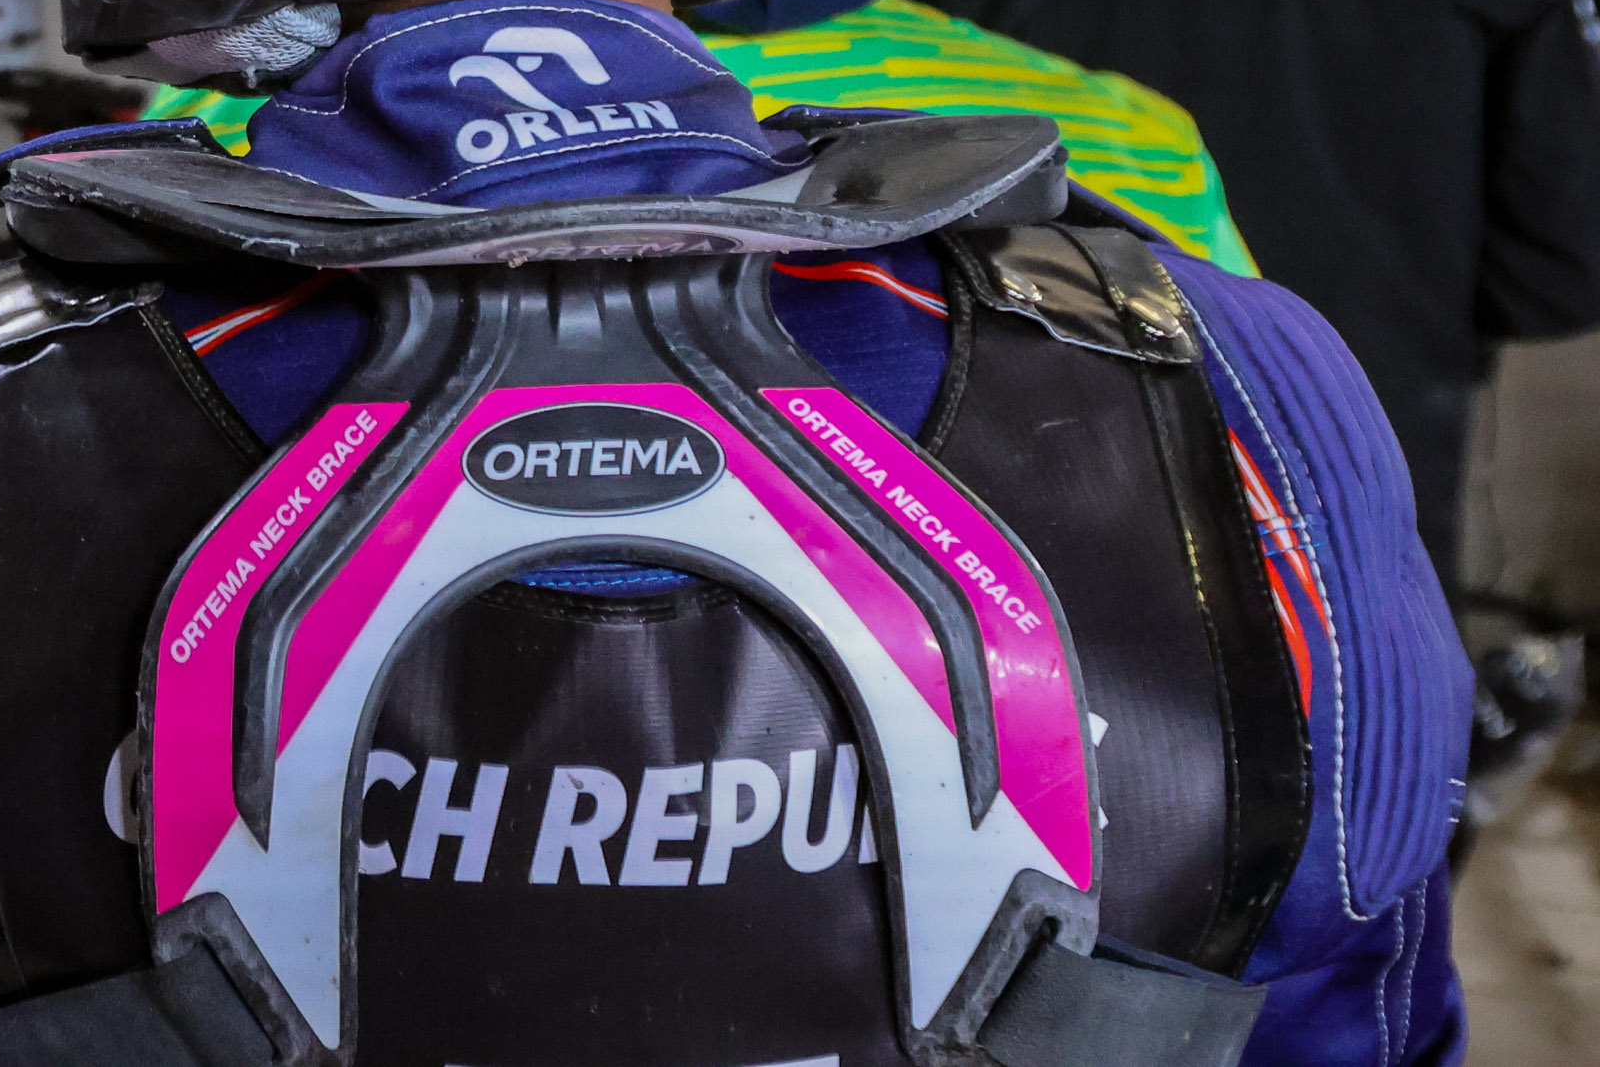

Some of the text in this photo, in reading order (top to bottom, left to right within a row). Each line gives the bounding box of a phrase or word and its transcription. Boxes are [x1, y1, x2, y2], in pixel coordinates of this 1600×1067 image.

[455, 99, 680, 165] ORLEN
[482, 435, 703, 481] ORTEMA
[787, 397, 1043, 635] ORTEMA NECK BRACE
[169, 409, 378, 665] ORTEMA NECK BRACE
